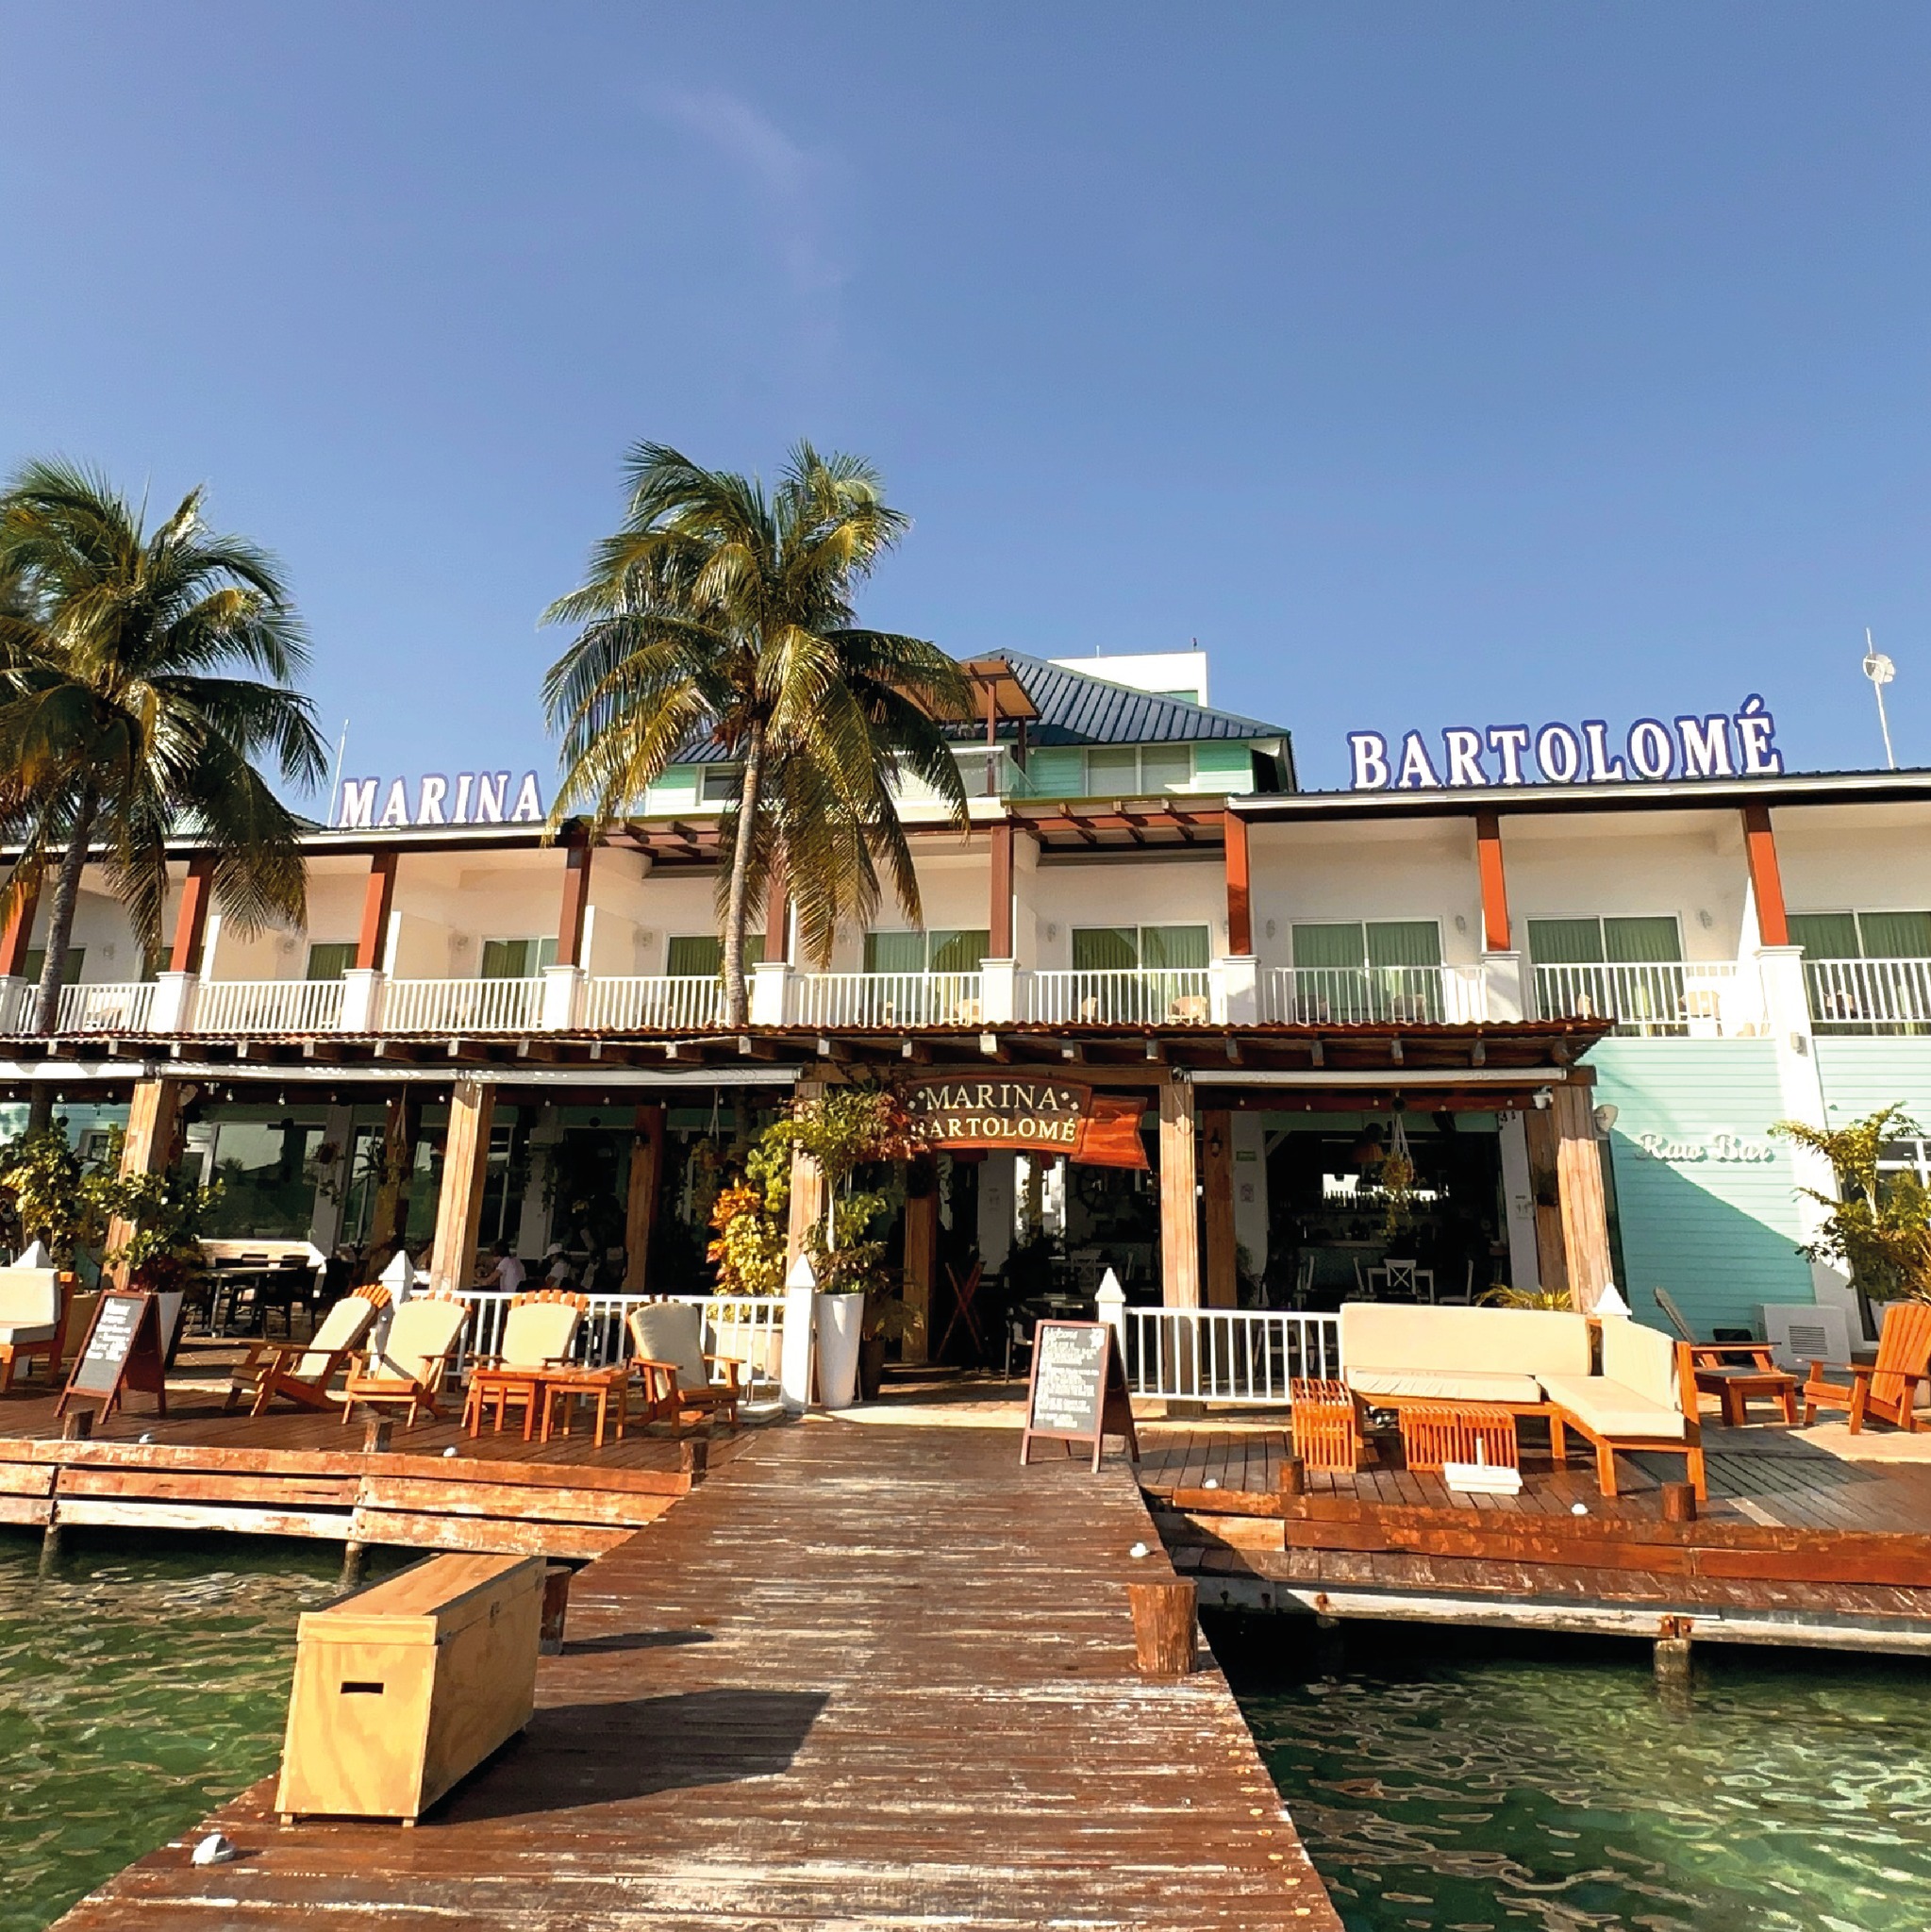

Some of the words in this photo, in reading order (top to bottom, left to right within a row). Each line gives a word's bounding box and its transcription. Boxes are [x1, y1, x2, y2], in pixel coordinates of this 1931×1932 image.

[1347, 693, 1784, 790] BARTOLOMÉ
[337, 770, 545, 827] MARINA
[924, 1085, 1059, 1110] MARINA
[1711, 1134, 1773, 1161] Bar
